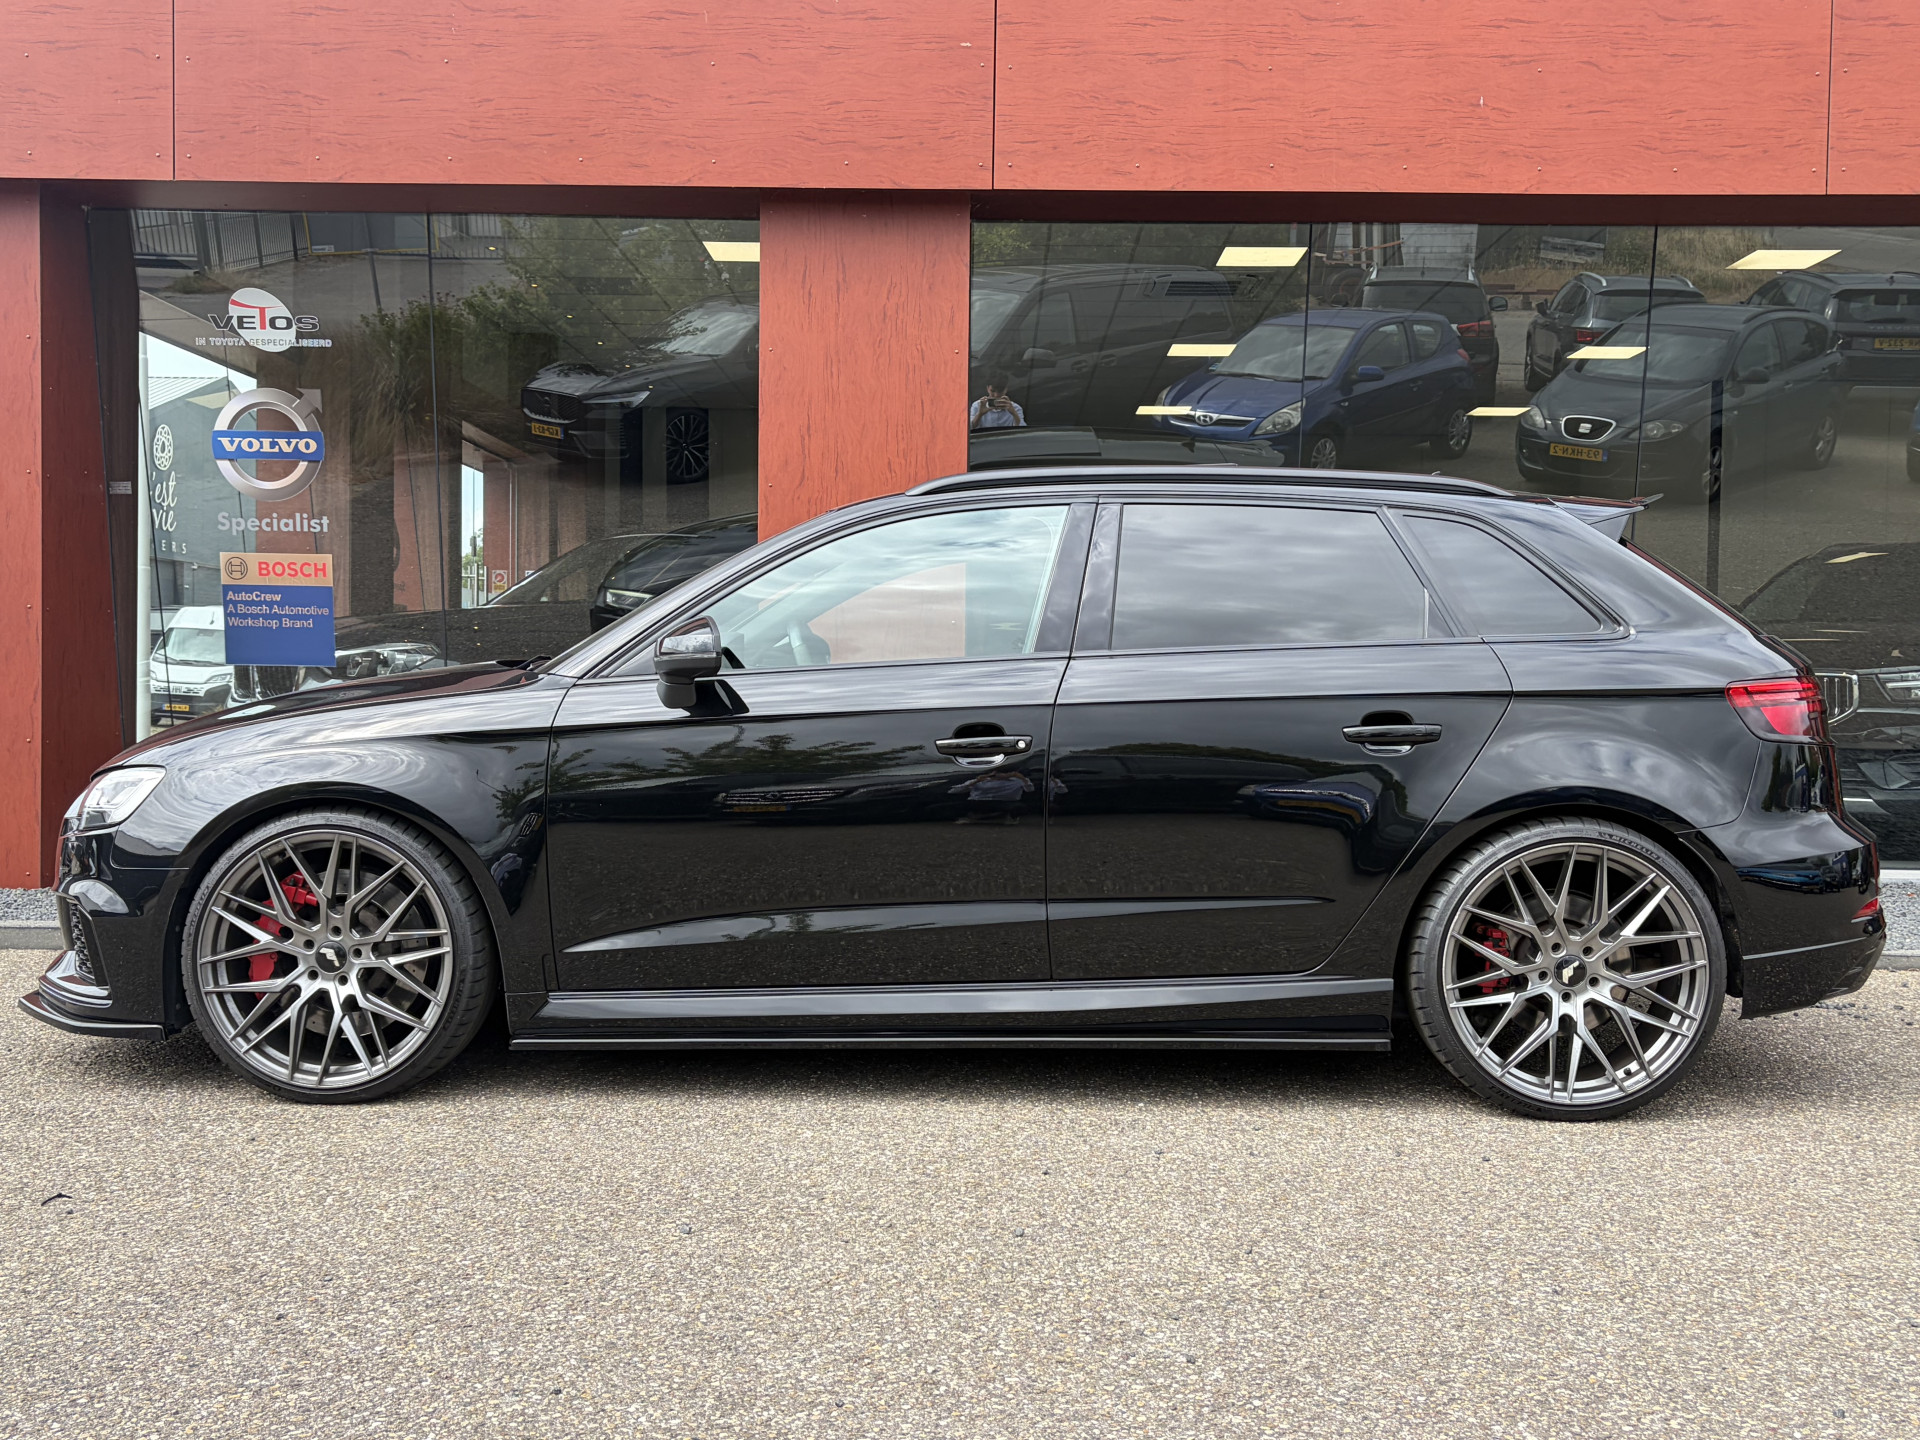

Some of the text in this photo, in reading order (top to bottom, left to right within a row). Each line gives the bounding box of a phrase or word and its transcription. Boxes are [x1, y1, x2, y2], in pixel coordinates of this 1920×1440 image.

[208, 299, 320, 331] VETOS
[195, 337, 206, 346] IN
[209, 337, 247, 347] TOYOTA
[217, 437, 318, 453] VOLVO
[217, 511, 330, 536] Specialist
[257, 561, 327, 578] BOSCH
[226, 591, 281, 601] AutoCrew
[227, 604, 329, 615] A Bosch Automotive
[228, 617, 313, 629] Workshop Brand
